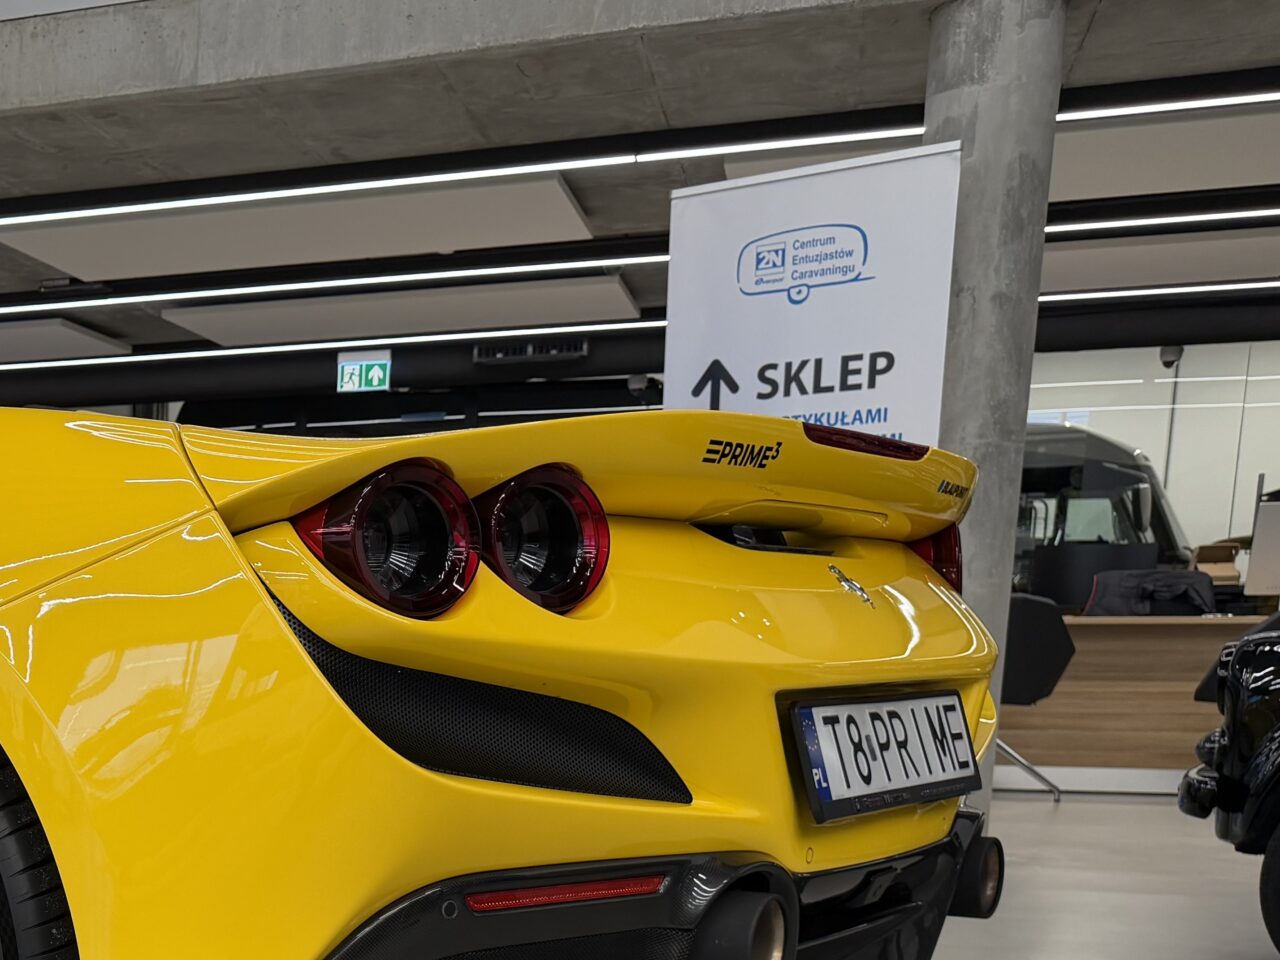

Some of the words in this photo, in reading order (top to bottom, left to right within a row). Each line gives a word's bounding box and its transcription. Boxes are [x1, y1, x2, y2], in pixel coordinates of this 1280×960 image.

[792, 236, 836, 250] Centrum
[757, 249, 784, 269] 2N
[792, 248, 854, 266] Entuzjastów
[791, 264, 855, 281] Caravaningu
[756, 351, 896, 400] SKLEP
[812, 768, 829, 789] PL
